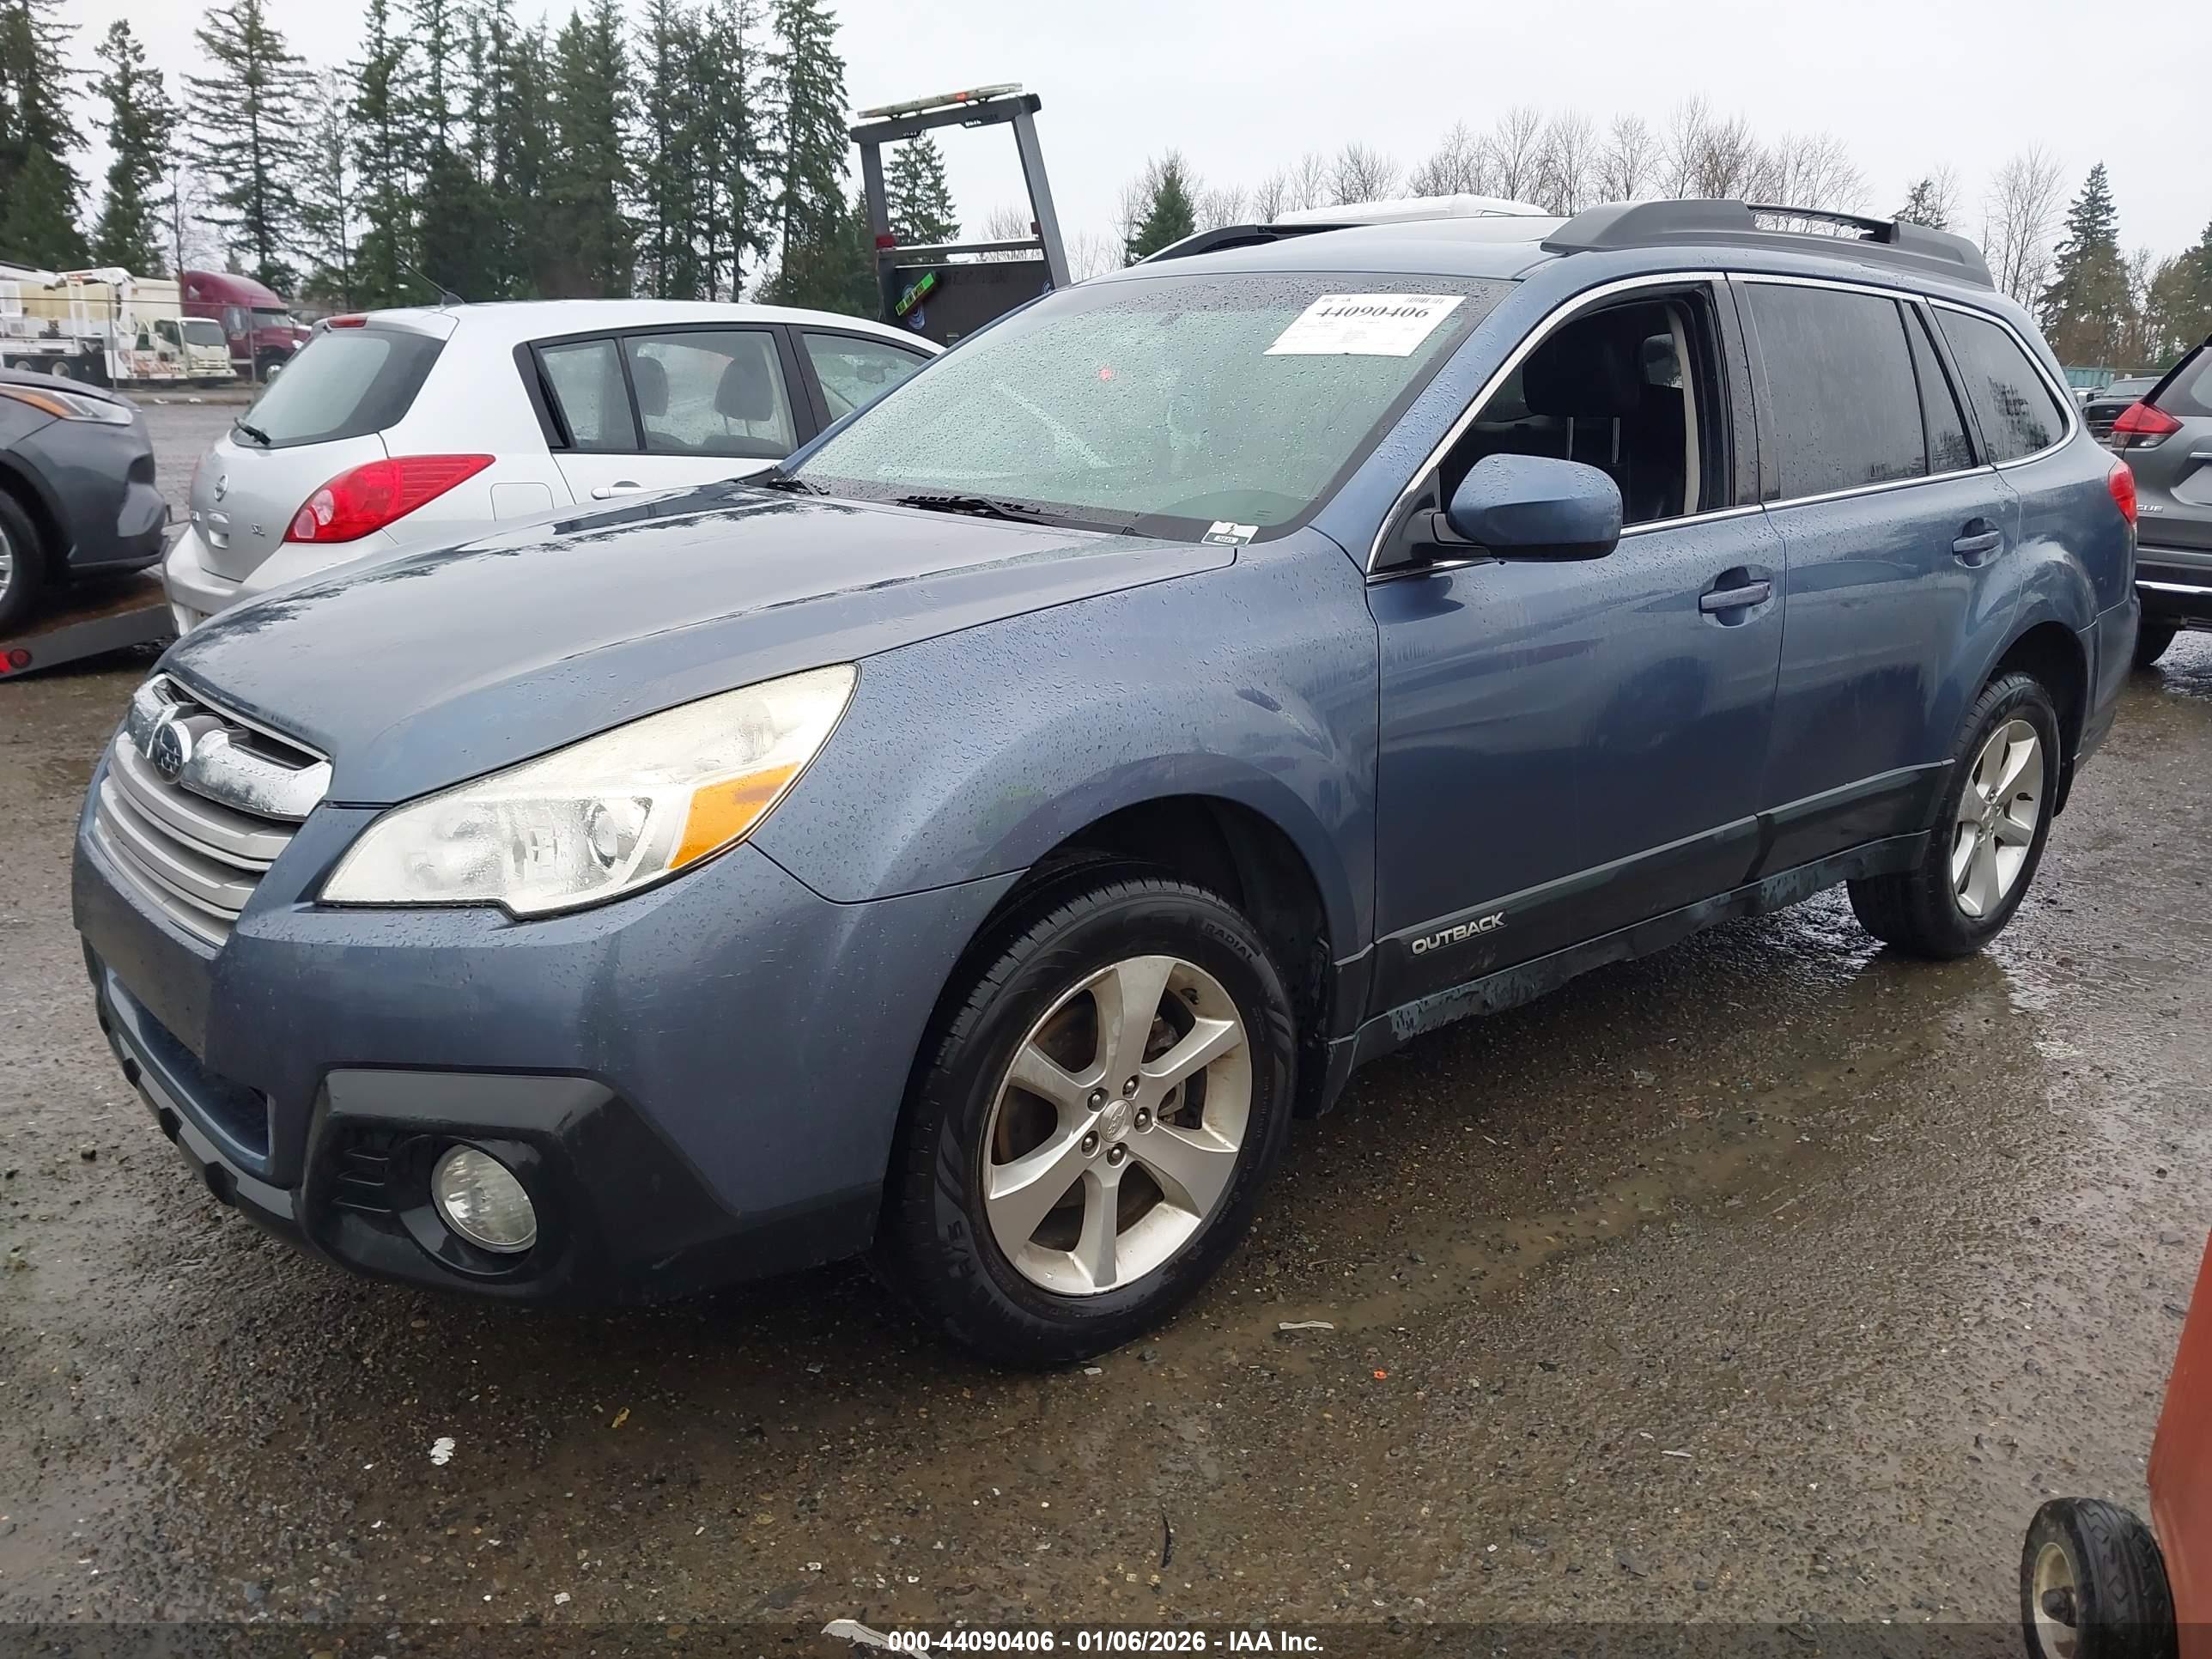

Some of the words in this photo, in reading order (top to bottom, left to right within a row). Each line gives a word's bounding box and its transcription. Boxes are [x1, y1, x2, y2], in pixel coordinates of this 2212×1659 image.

[1316, 306, 1431, 318] 44090406
[2136, 504, 2164, 513] GUE
[251, 523, 265, 536] SL
[1411, 911, 1505, 955] OUTBACK
[1204, 922, 1254, 963] RADIAL
